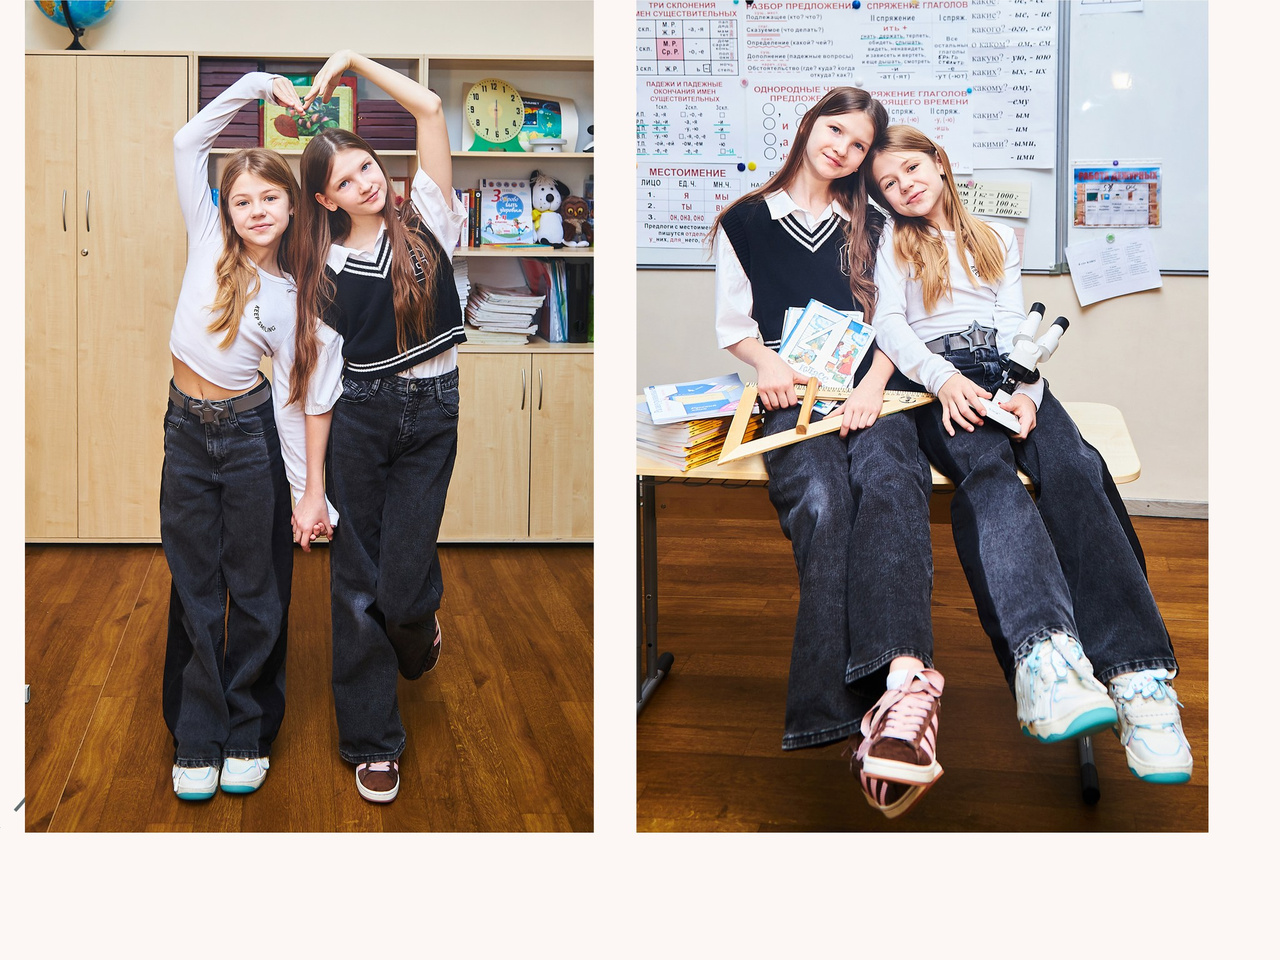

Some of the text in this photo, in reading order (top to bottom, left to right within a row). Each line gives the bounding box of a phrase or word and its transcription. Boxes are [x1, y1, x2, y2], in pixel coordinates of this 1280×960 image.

[866, 2, 920, 10] СПРЯЖЕНИЕ
[649, 168, 726, 177] МЕСТОИМЕНИЕ
[1078, 171, 1158, 181] РАБОТА ДЕЖУРНЫХ
[491, 189, 501, 202] 3
